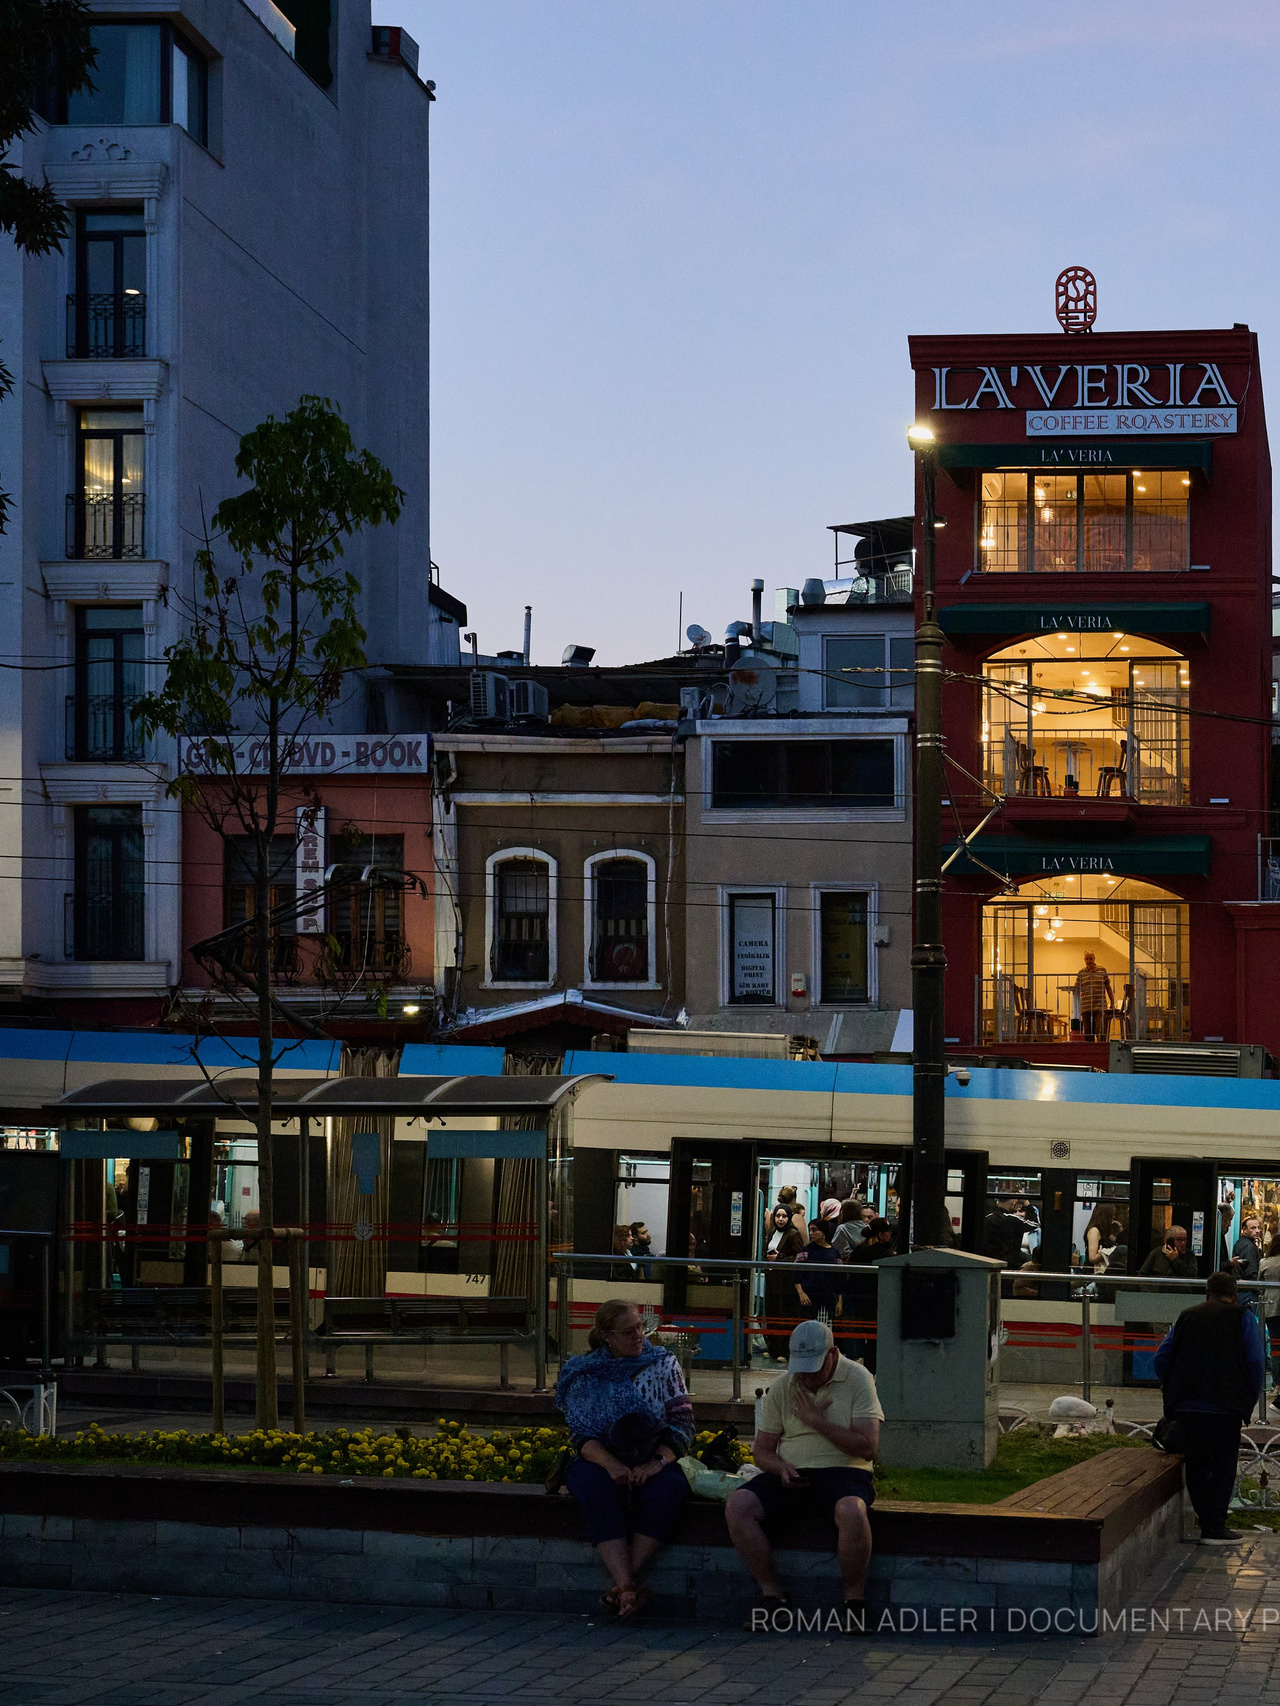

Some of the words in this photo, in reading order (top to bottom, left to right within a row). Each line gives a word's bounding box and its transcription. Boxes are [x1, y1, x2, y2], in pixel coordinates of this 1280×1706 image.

[931, 363, 1238, 410] LA'VERIA
[1028, 414, 1109, 431] COFFEE
[1116, 412, 1234, 430] ROASTERY
[1068, 449, 1113, 462] VERIA
[1067, 615, 1113, 628] VERIA
[355, 740, 422, 767] BOOK
[1069, 857, 1114, 869] VERIA
[465, 1273, 486, 1284] 747
